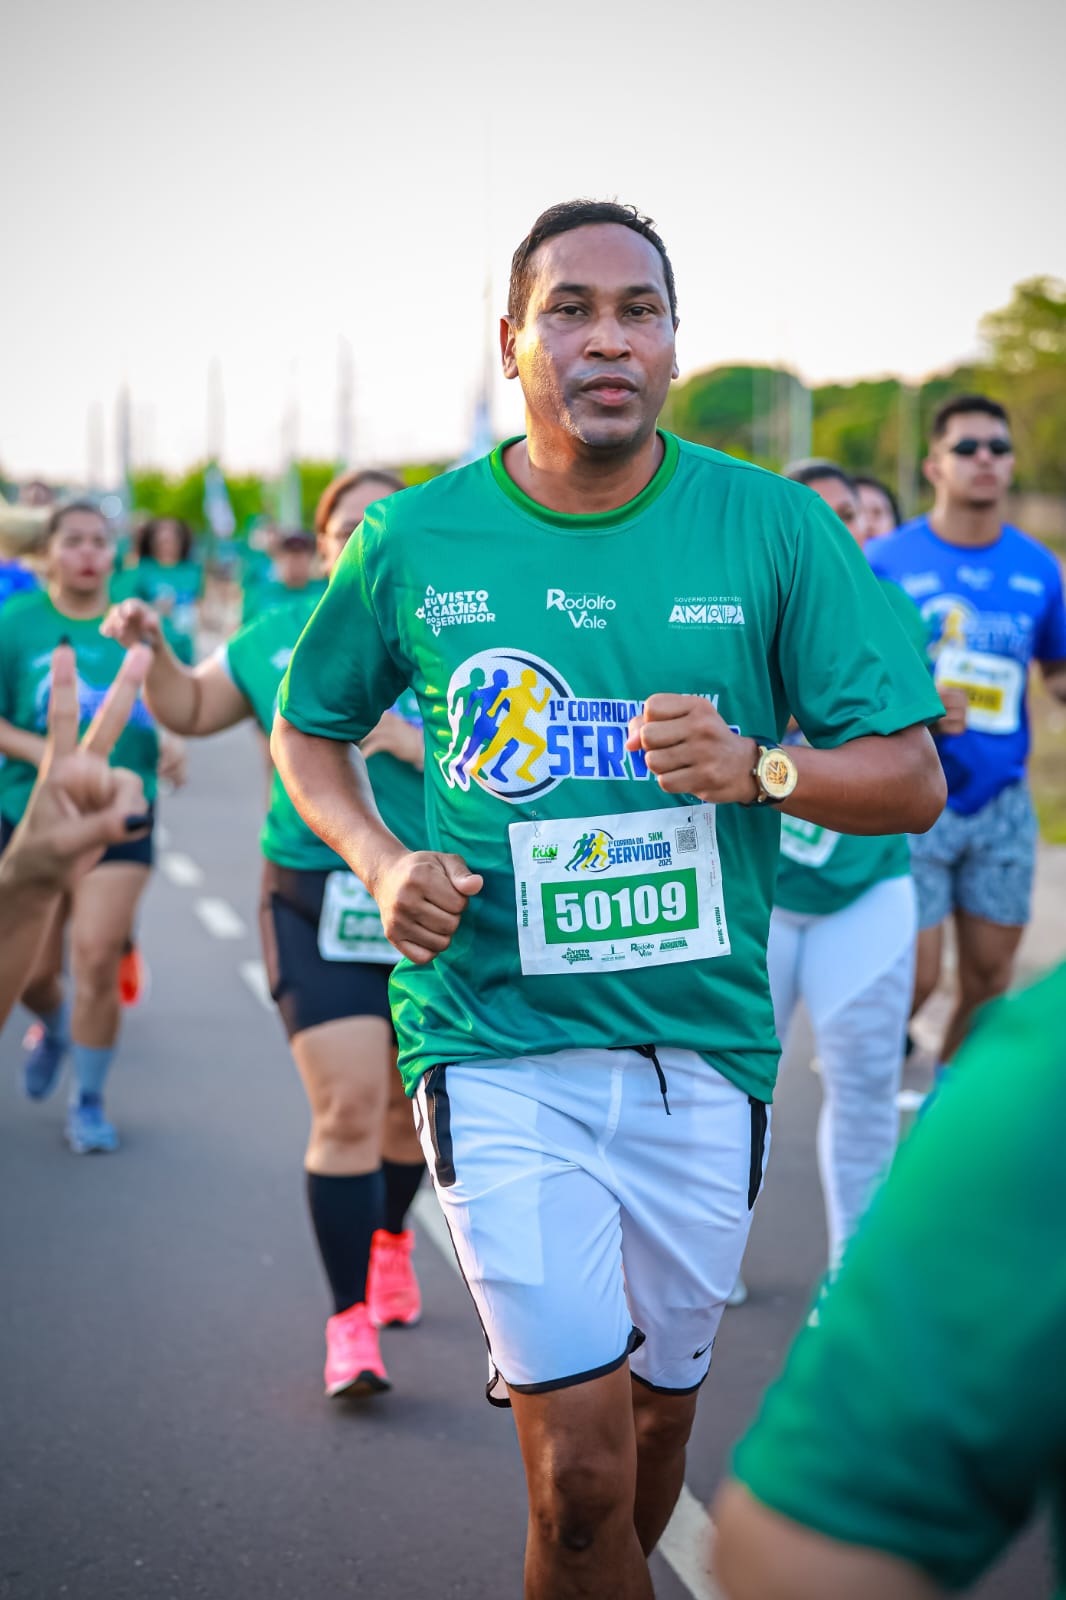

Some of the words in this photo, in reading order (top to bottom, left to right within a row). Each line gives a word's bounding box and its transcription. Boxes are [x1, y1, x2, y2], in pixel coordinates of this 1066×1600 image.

[424, 597, 437, 608] EU
[436, 589, 489, 605] VISTO
[546, 588, 617, 611] Rodolfo
[432, 601, 489, 617] CAMISA
[436, 612, 496, 627] SERVIDOR
[567, 610, 607, 629] Vale
[613, 838, 635, 847] CORRIDA
[635, 837, 644, 845] DO
[648, 831, 663, 841] 5KM
[608, 841, 671, 865] SERVIDOR
[658, 858, 672, 867] 2025
[555, 881, 686, 933] 50109
